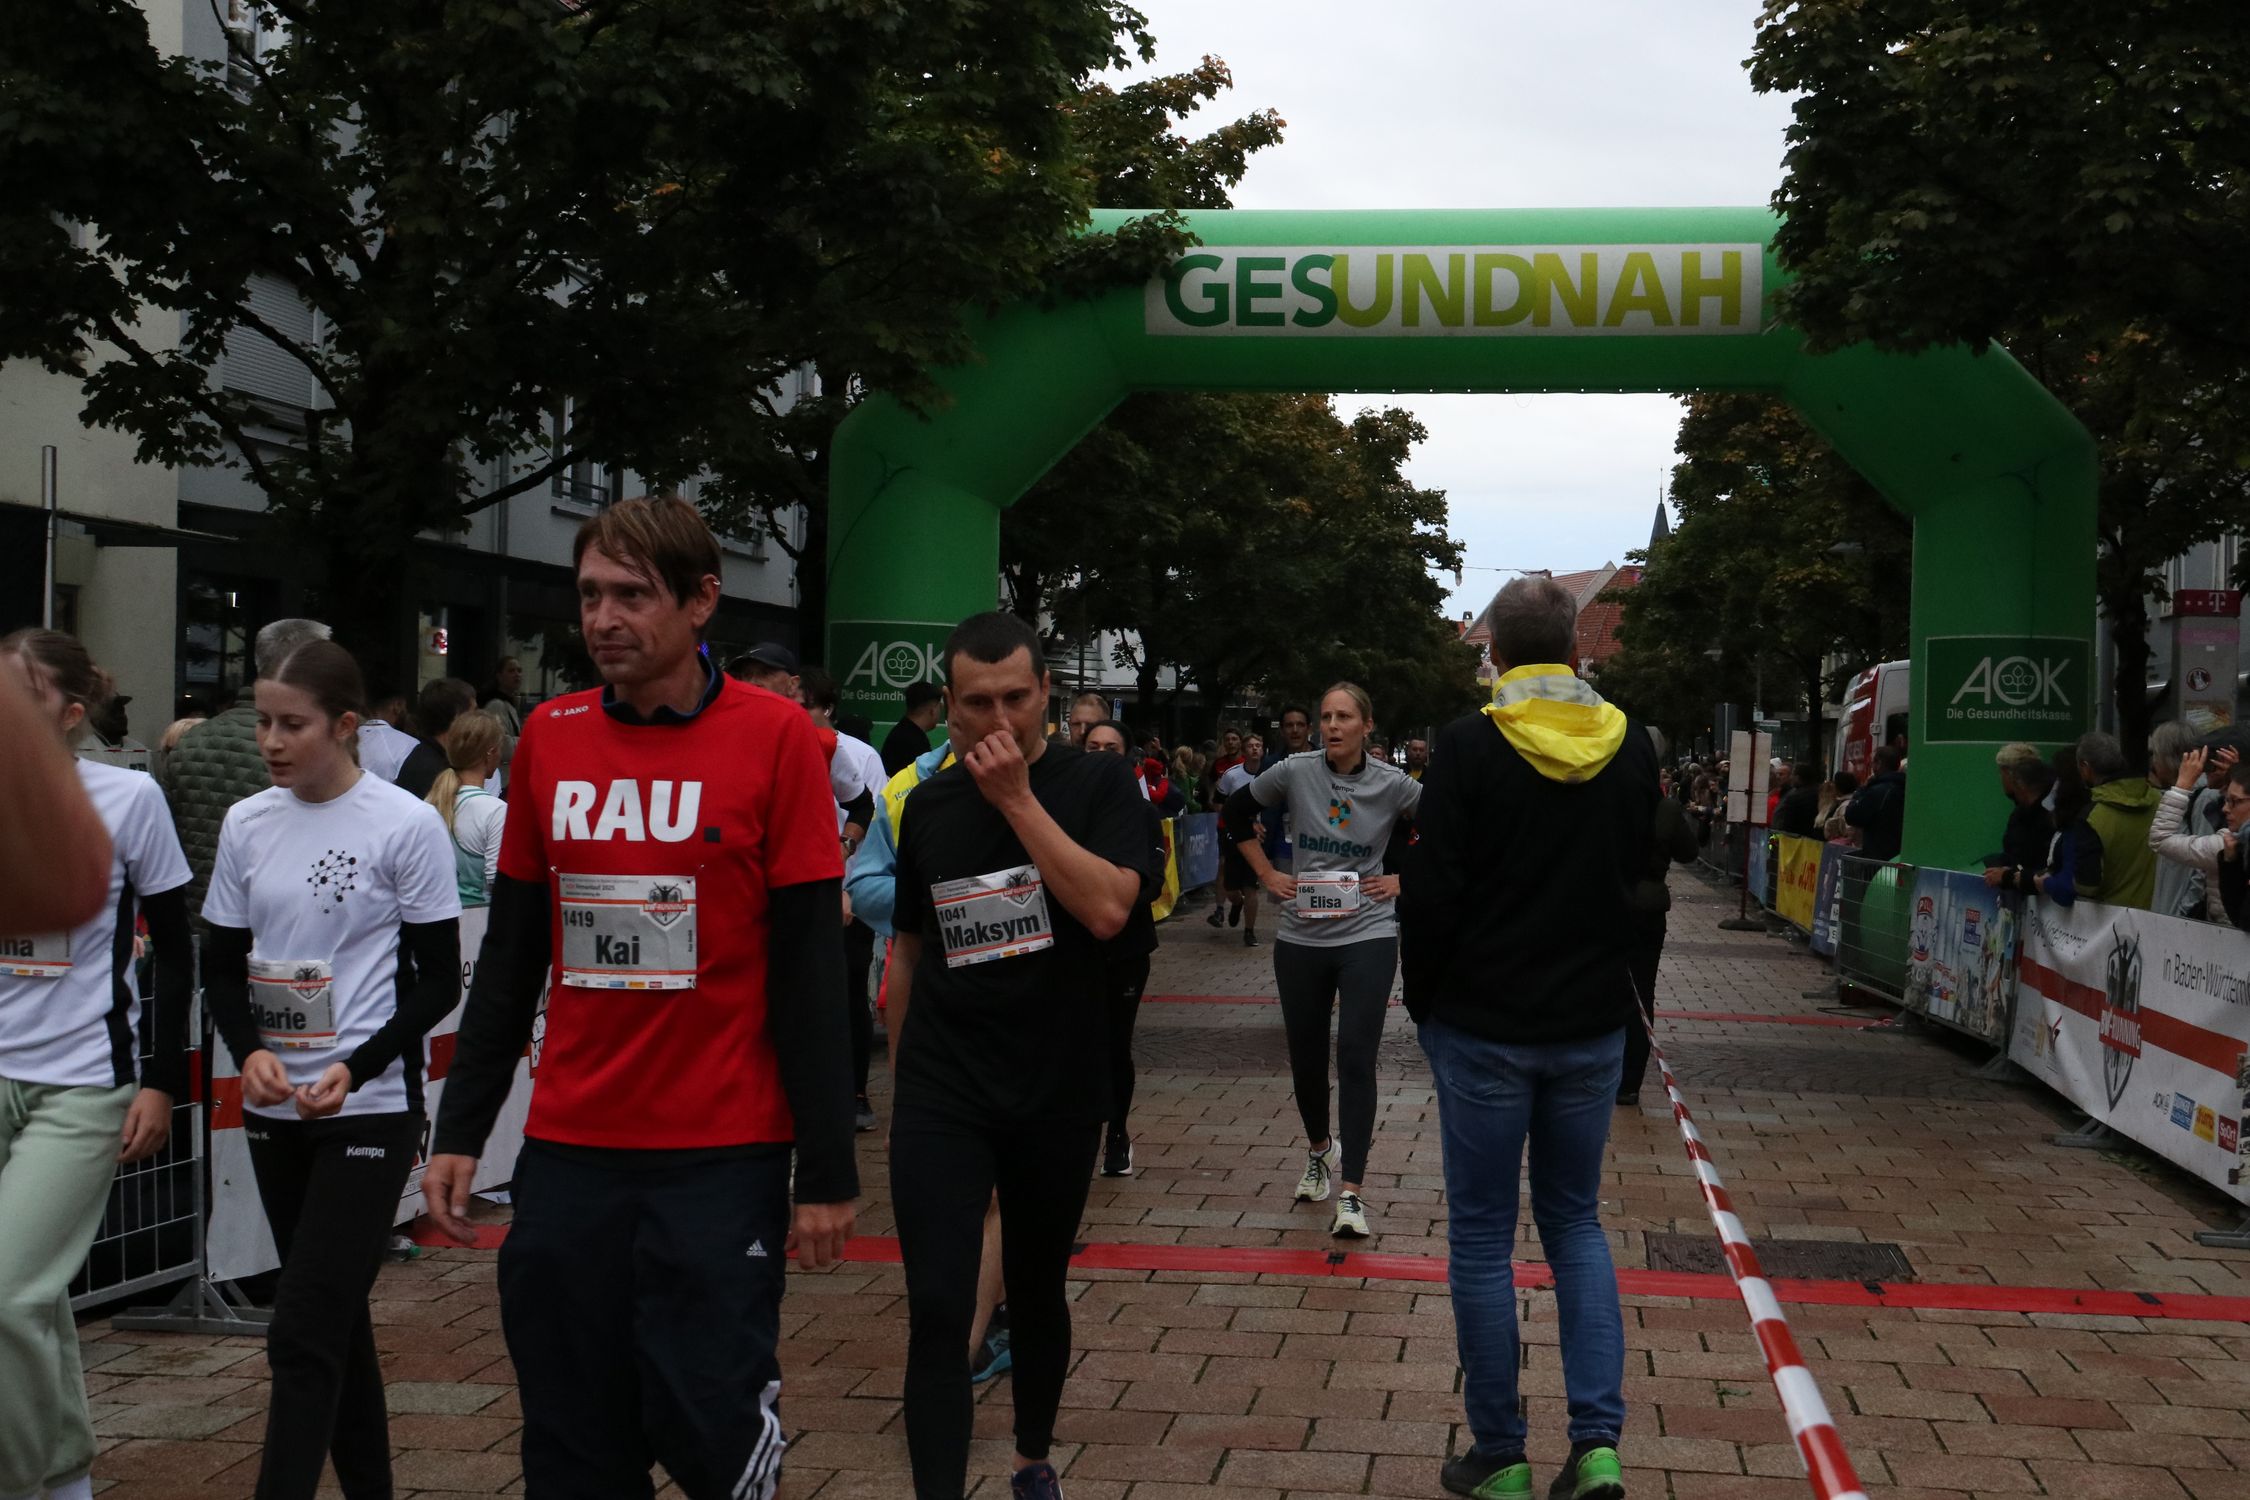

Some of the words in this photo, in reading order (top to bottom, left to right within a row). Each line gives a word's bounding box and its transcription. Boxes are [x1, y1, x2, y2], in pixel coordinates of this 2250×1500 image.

[1164, 251, 1742, 327] GESUNDNAH
[843, 640, 947, 688] AOK
[1950, 655, 2071, 706] AOK
[563, 705, 589, 716] JAKO
[1946, 708, 1964, 720] Die
[1299, 834, 1372, 857] Balingen
[1310, 896, 1342, 908] Elisa
[564, 910, 594, 927] 1419
[939, 906, 967, 922] 1041
[944, 914, 1040, 950] Maksym
[596, 935, 639, 965] Kai
[346, 1145, 385, 1159] Kempa
